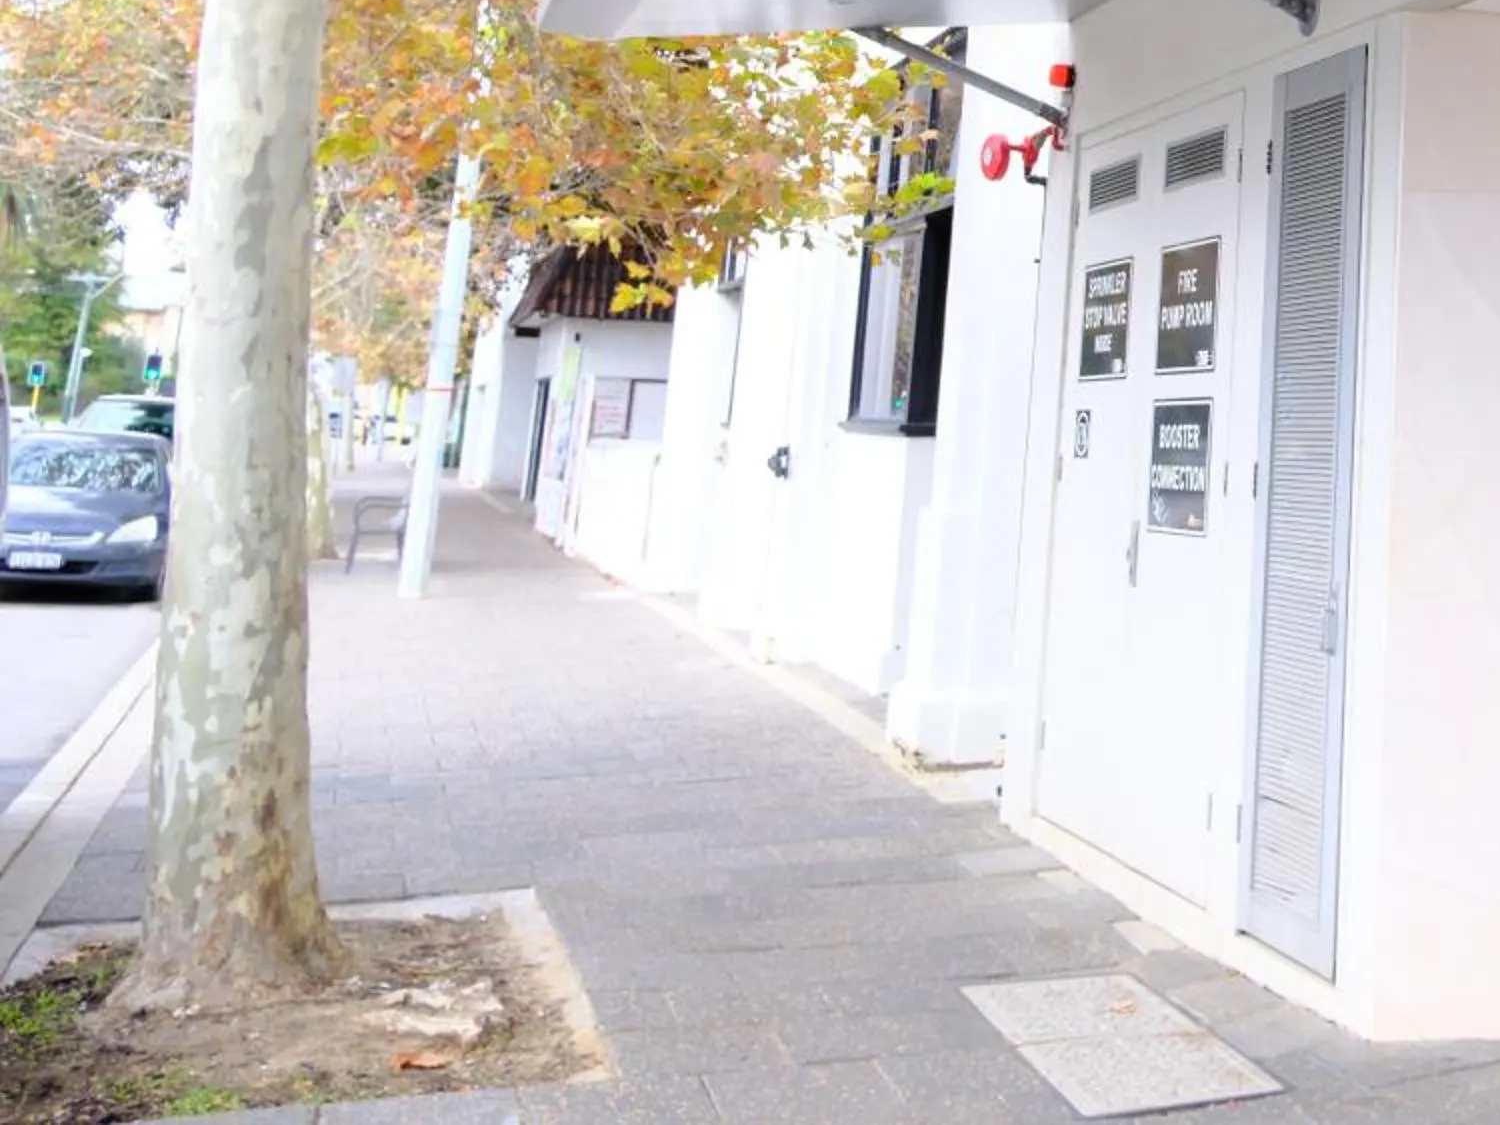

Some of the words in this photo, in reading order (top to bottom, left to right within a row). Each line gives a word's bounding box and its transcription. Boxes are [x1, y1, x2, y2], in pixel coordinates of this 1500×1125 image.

[1088, 271, 1127, 299] SPRINKLER
[1178, 268, 1198, 295] FIRE
[1085, 305, 1103, 329] STOP
[1103, 302, 1127, 327] VALVE
[1161, 304, 1185, 330] PUMP
[1185, 300, 1213, 327] ROOM
[1159, 423, 1200, 449] BOOSTER
[1151, 464, 1205, 491] CONNECTION
